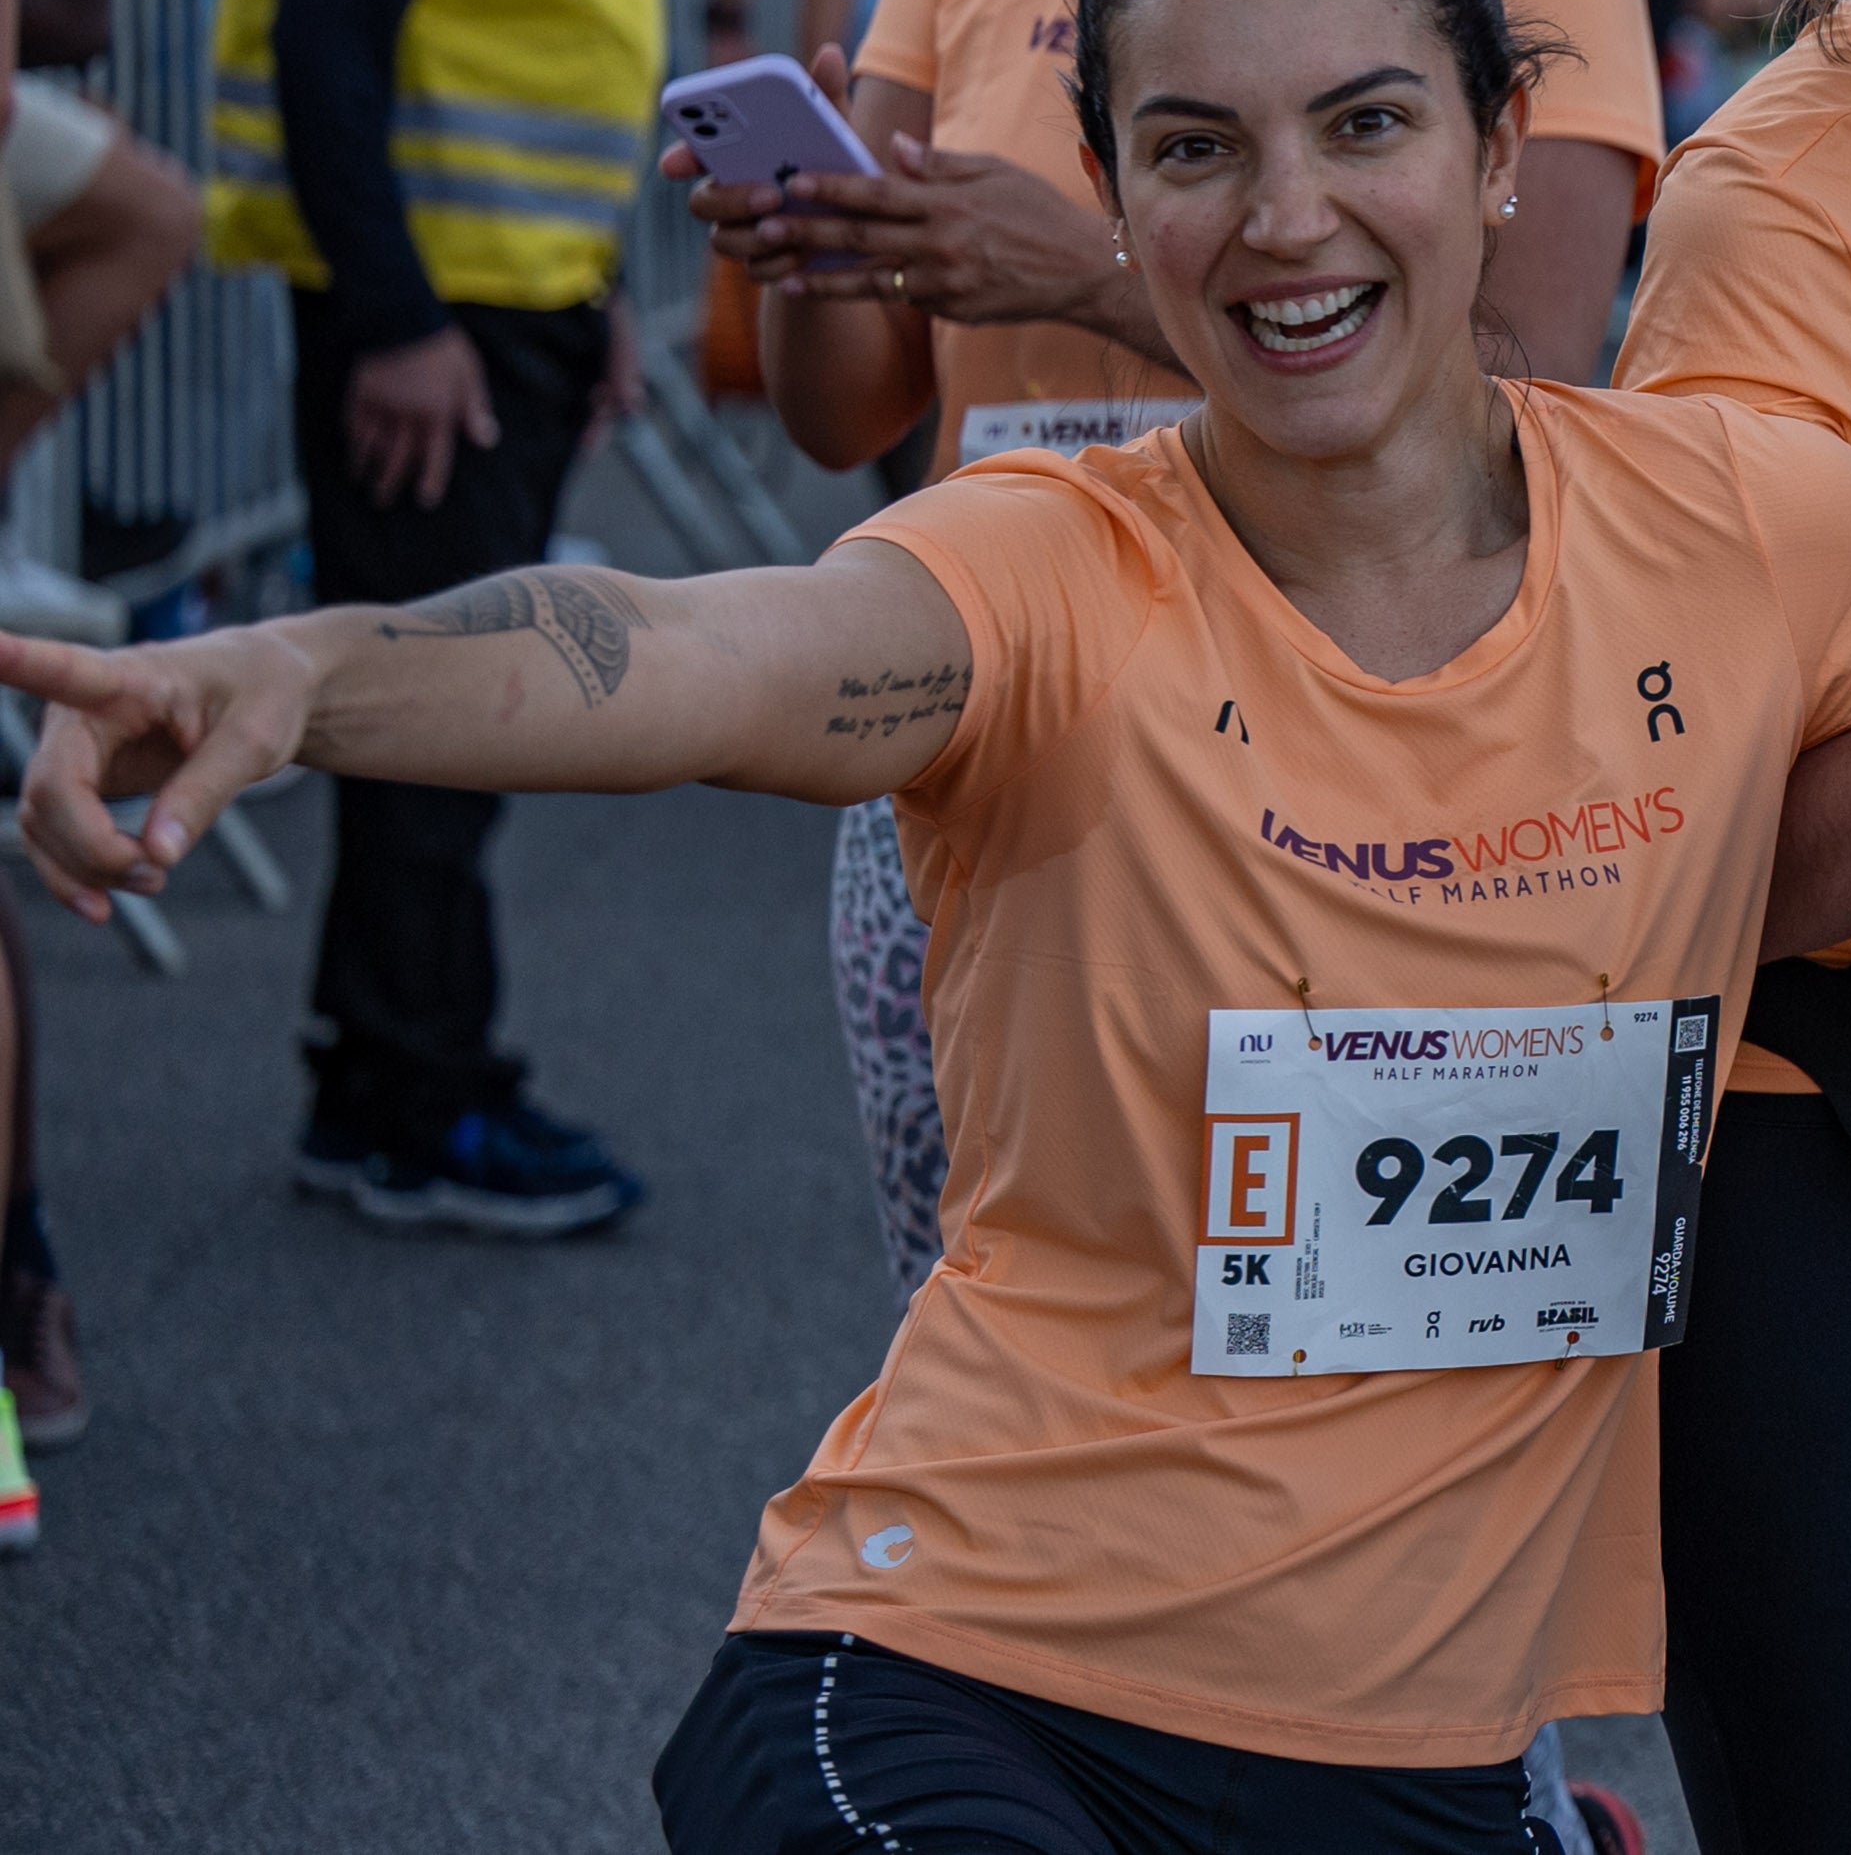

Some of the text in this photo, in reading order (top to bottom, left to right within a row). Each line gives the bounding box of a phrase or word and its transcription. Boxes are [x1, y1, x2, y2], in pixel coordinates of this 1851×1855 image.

[1453, 786, 1686, 873] WOMEN'S
[1443, 862, 1622, 906] MARATHON
[1239, 1034, 1273, 1053] nu
[1326, 1025, 1584, 1061] VENUS WOMEN'S
[1373, 1064, 1539, 1081] HALF MARATHON
[1677, 1075, 1692, 1151] 11 955 006 296
[1693, 1099, 1702, 1111] DE
[1229, 1135, 1270, 1227] E
[1356, 1130, 1623, 1225] 9274
[1222, 1254, 1271, 1286] 5K
[1404, 1244, 1571, 1277] GIOVANNA
[1652, 1252, 1672, 1295] 9274
[1664, 1217, 1686, 1324] GUARDA-VOLUME
[1468, 1313, 1506, 1333] rvb
[1537, 1306, 1599, 1327] BRASIL
